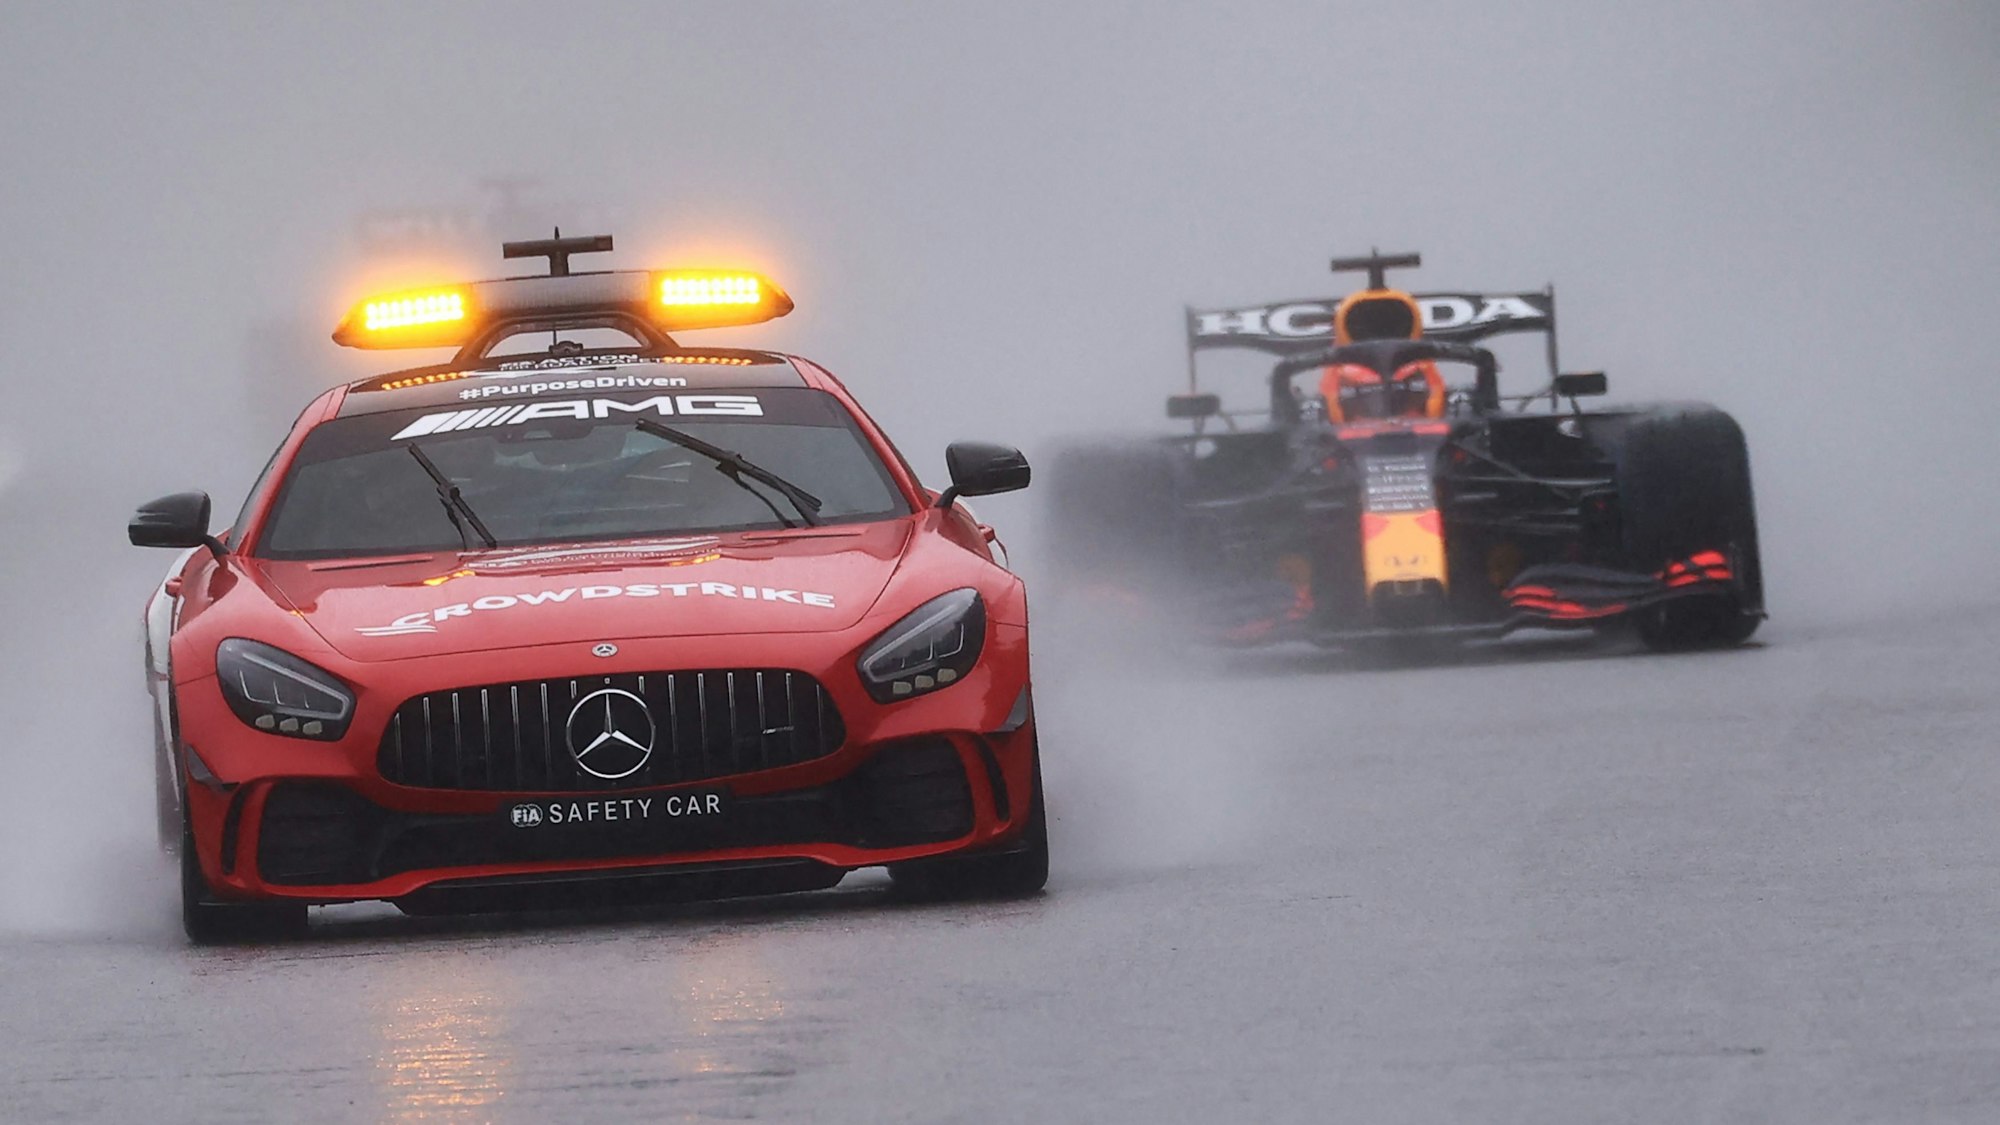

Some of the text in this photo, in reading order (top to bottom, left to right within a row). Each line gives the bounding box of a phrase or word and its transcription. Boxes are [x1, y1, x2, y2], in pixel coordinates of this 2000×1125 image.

[1198, 297, 1544, 336] HODA
[459, 375, 687, 400] #PurposeDriven
[507, 395, 763, 425] AMG
[392, 581, 836, 627] CROWDSTRIKE
[549, 799, 651, 823] SAFETY
[667, 794, 720, 816] CAR
